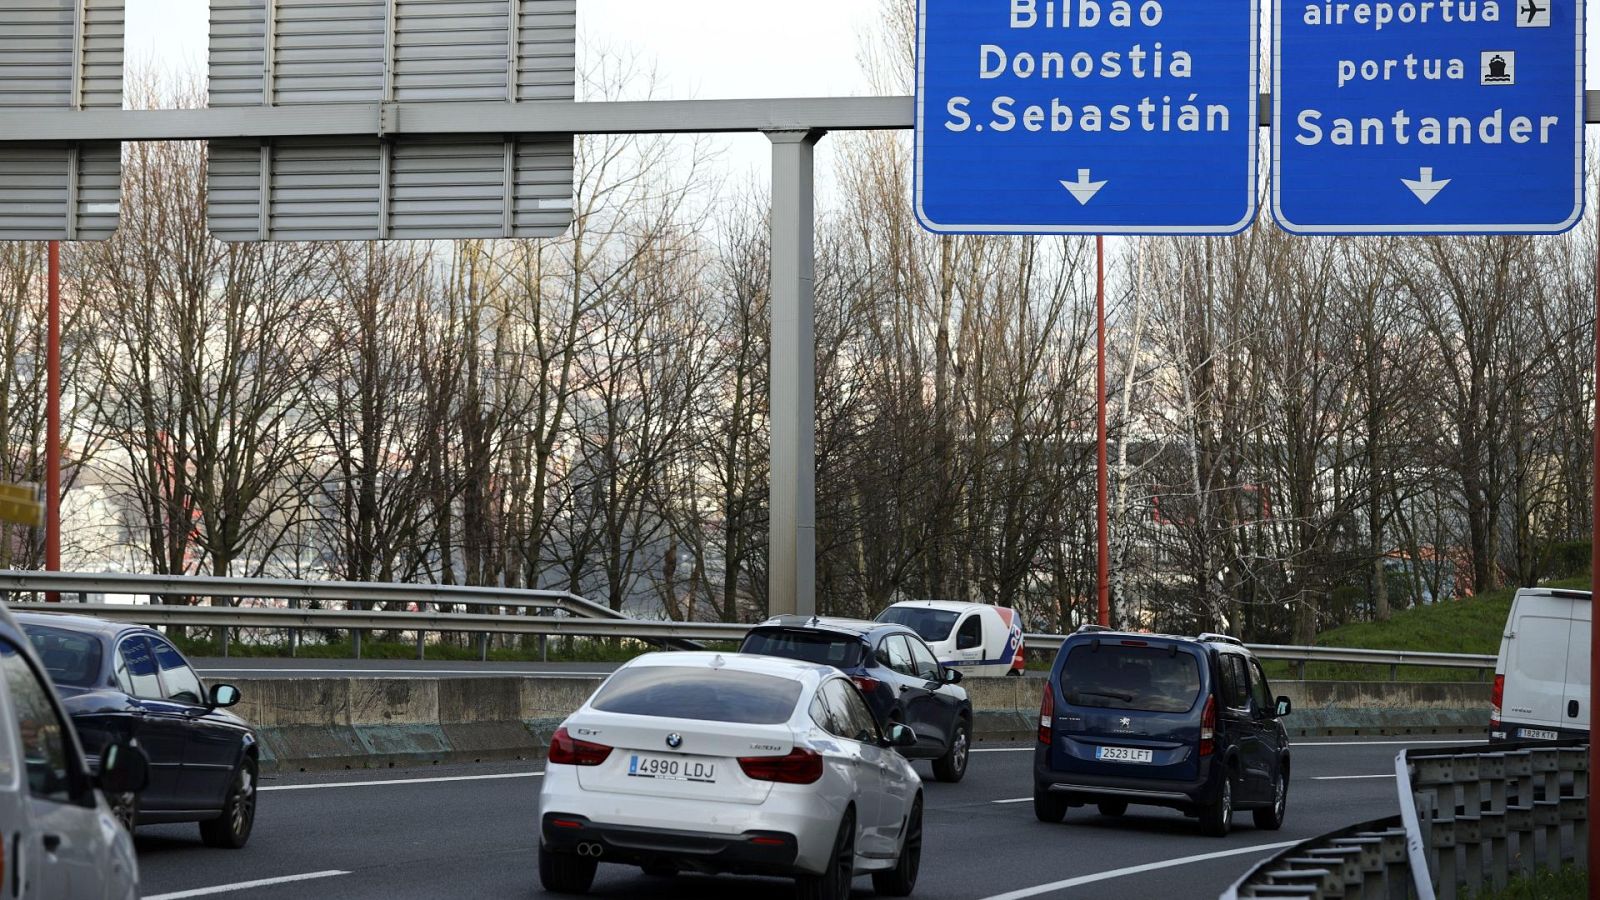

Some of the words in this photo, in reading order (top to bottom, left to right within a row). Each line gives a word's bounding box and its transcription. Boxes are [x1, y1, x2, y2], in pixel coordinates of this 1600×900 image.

[1009, 0, 1163, 29] Bilbao
[1303, 0, 1500, 31] aireportua
[979, 42, 1192, 79] Donostia
[1338, 53, 1464, 88] portua
[944, 93, 1230, 132] S.Sebastián
[1295, 108, 1558, 146] Santander
[639, 758, 679, 775] 4990
[684, 762, 715, 779] LDJ
[1103, 748, 1128, 759] 2523
[1131, 750, 1153, 761] LFT
